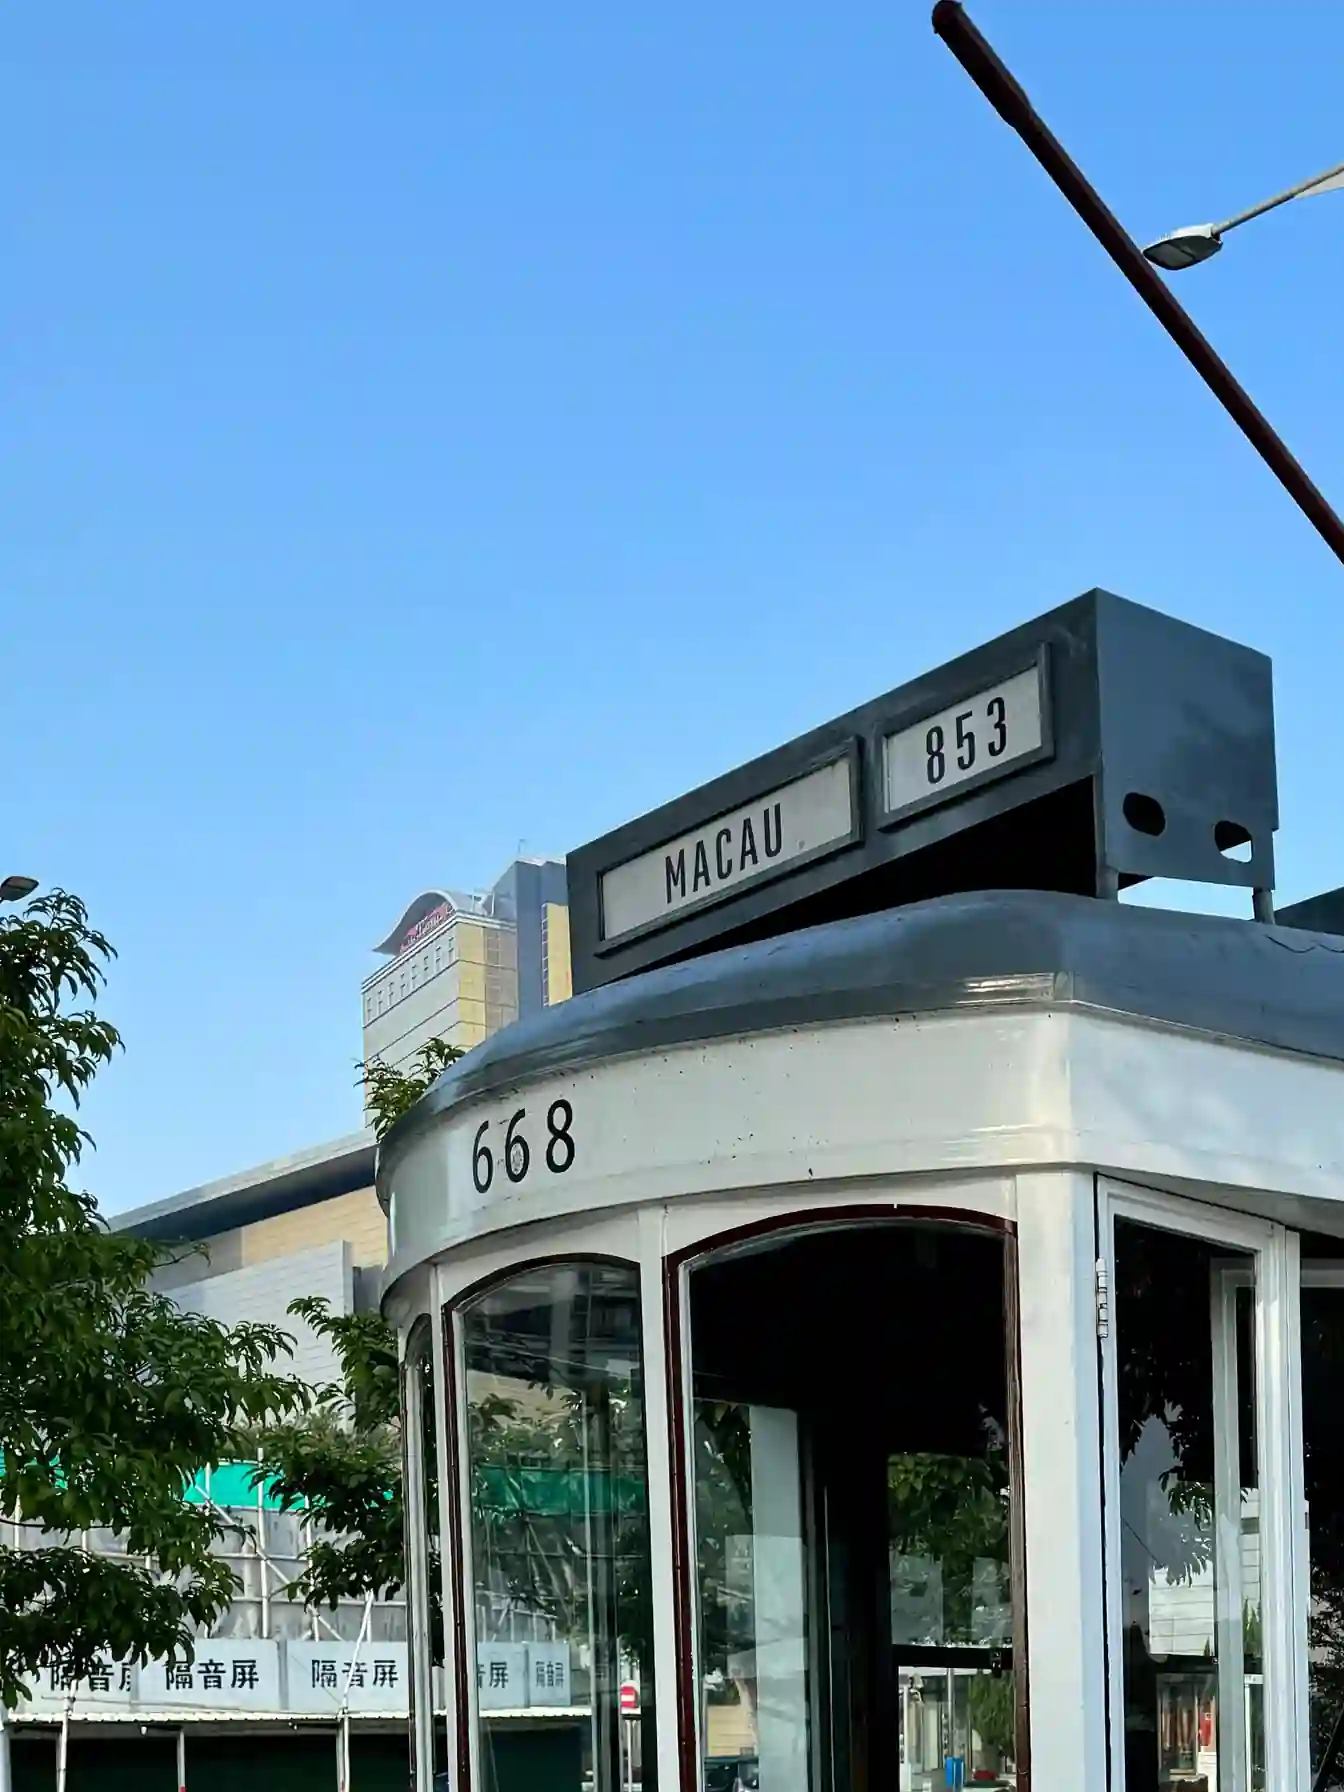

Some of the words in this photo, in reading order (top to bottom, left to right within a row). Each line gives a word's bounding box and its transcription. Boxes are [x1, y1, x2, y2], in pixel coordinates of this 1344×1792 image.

[925, 696, 1007, 784] 853
[665, 803, 782, 904] MACAU
[472, 1099, 575, 1193] 668
[166, 1659, 260, 1690] 隔音屏
[311, 1659, 399, 1689] 隔音屏
